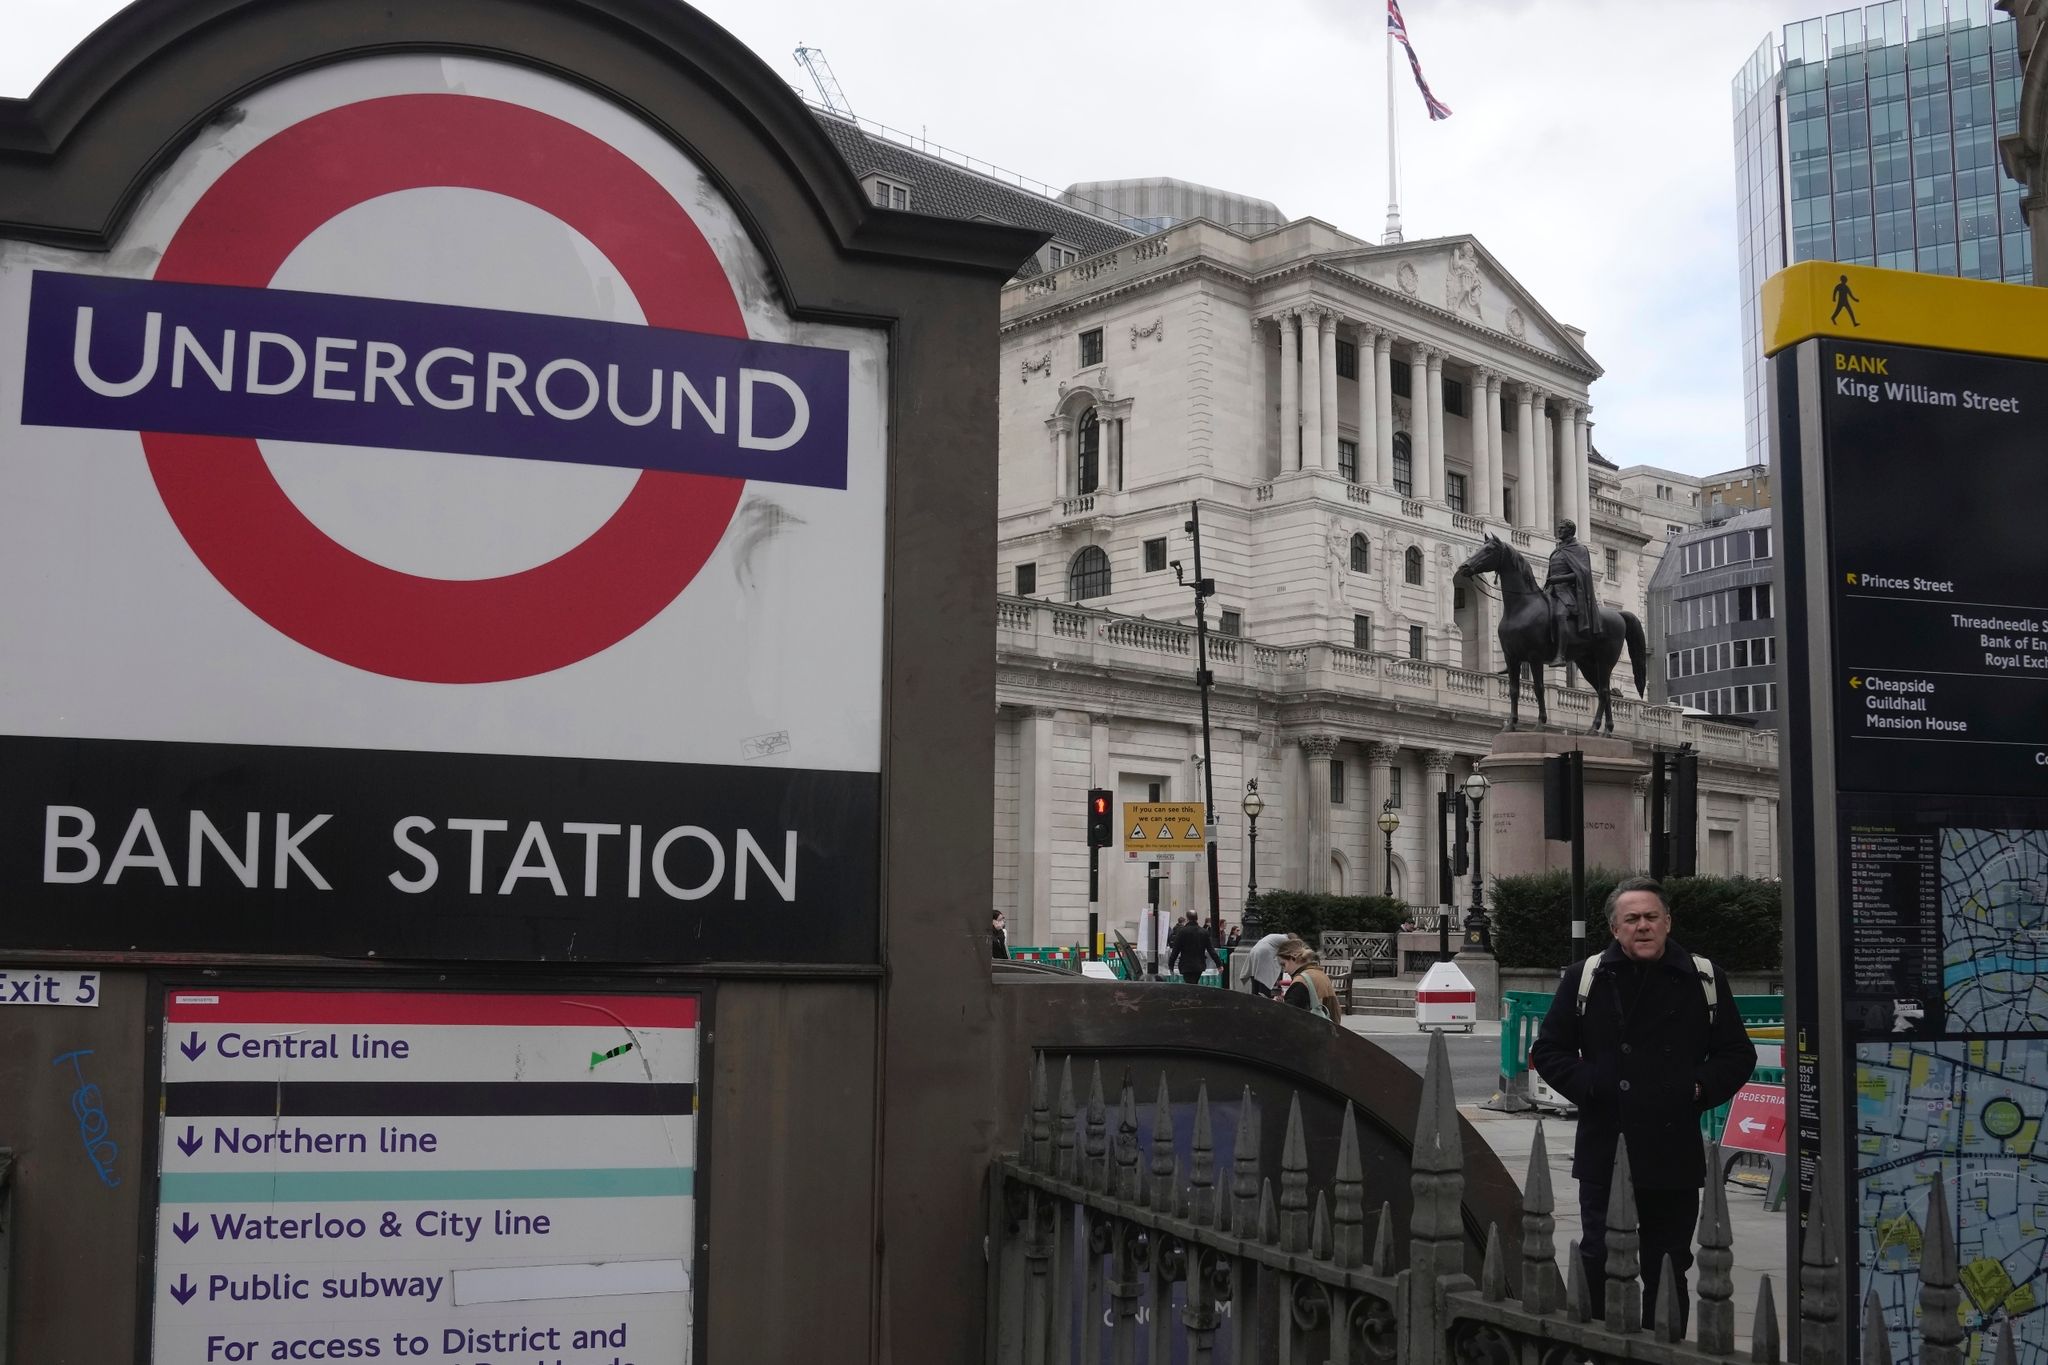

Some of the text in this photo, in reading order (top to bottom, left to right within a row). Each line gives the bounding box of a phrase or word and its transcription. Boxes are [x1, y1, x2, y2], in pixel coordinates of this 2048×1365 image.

[1836, 353, 1889, 376] BANK
[73, 306, 811, 452] UNDERGROUND
[1836, 376, 2020, 414] King William Street
[1861, 573, 1954, 593] Princes Street
[1951, 614, 2039, 633] Threadneedle
[1980, 634, 2012, 649] Bank
[2014, 636, 2029, 650] of
[1985, 652, 2021, 670] Royal
[1865, 676, 1935, 695] Cheapside
[1865, 695, 1927, 711] Guildhall
[1866, 713, 1967, 732] Mansion House
[43, 804, 798, 902] BANK STATION
[75, 974, 97, 1004] 5
[216, 1032, 410, 1059] Central line
[1799, 1074, 1811, 1083] 222
[214, 1124, 438, 1154] Northern line
[210, 1208, 551, 1243] Waterloo & City line
[209, 1271, 444, 1303] Public subway
[207, 1322, 627, 1363] For access to District and
